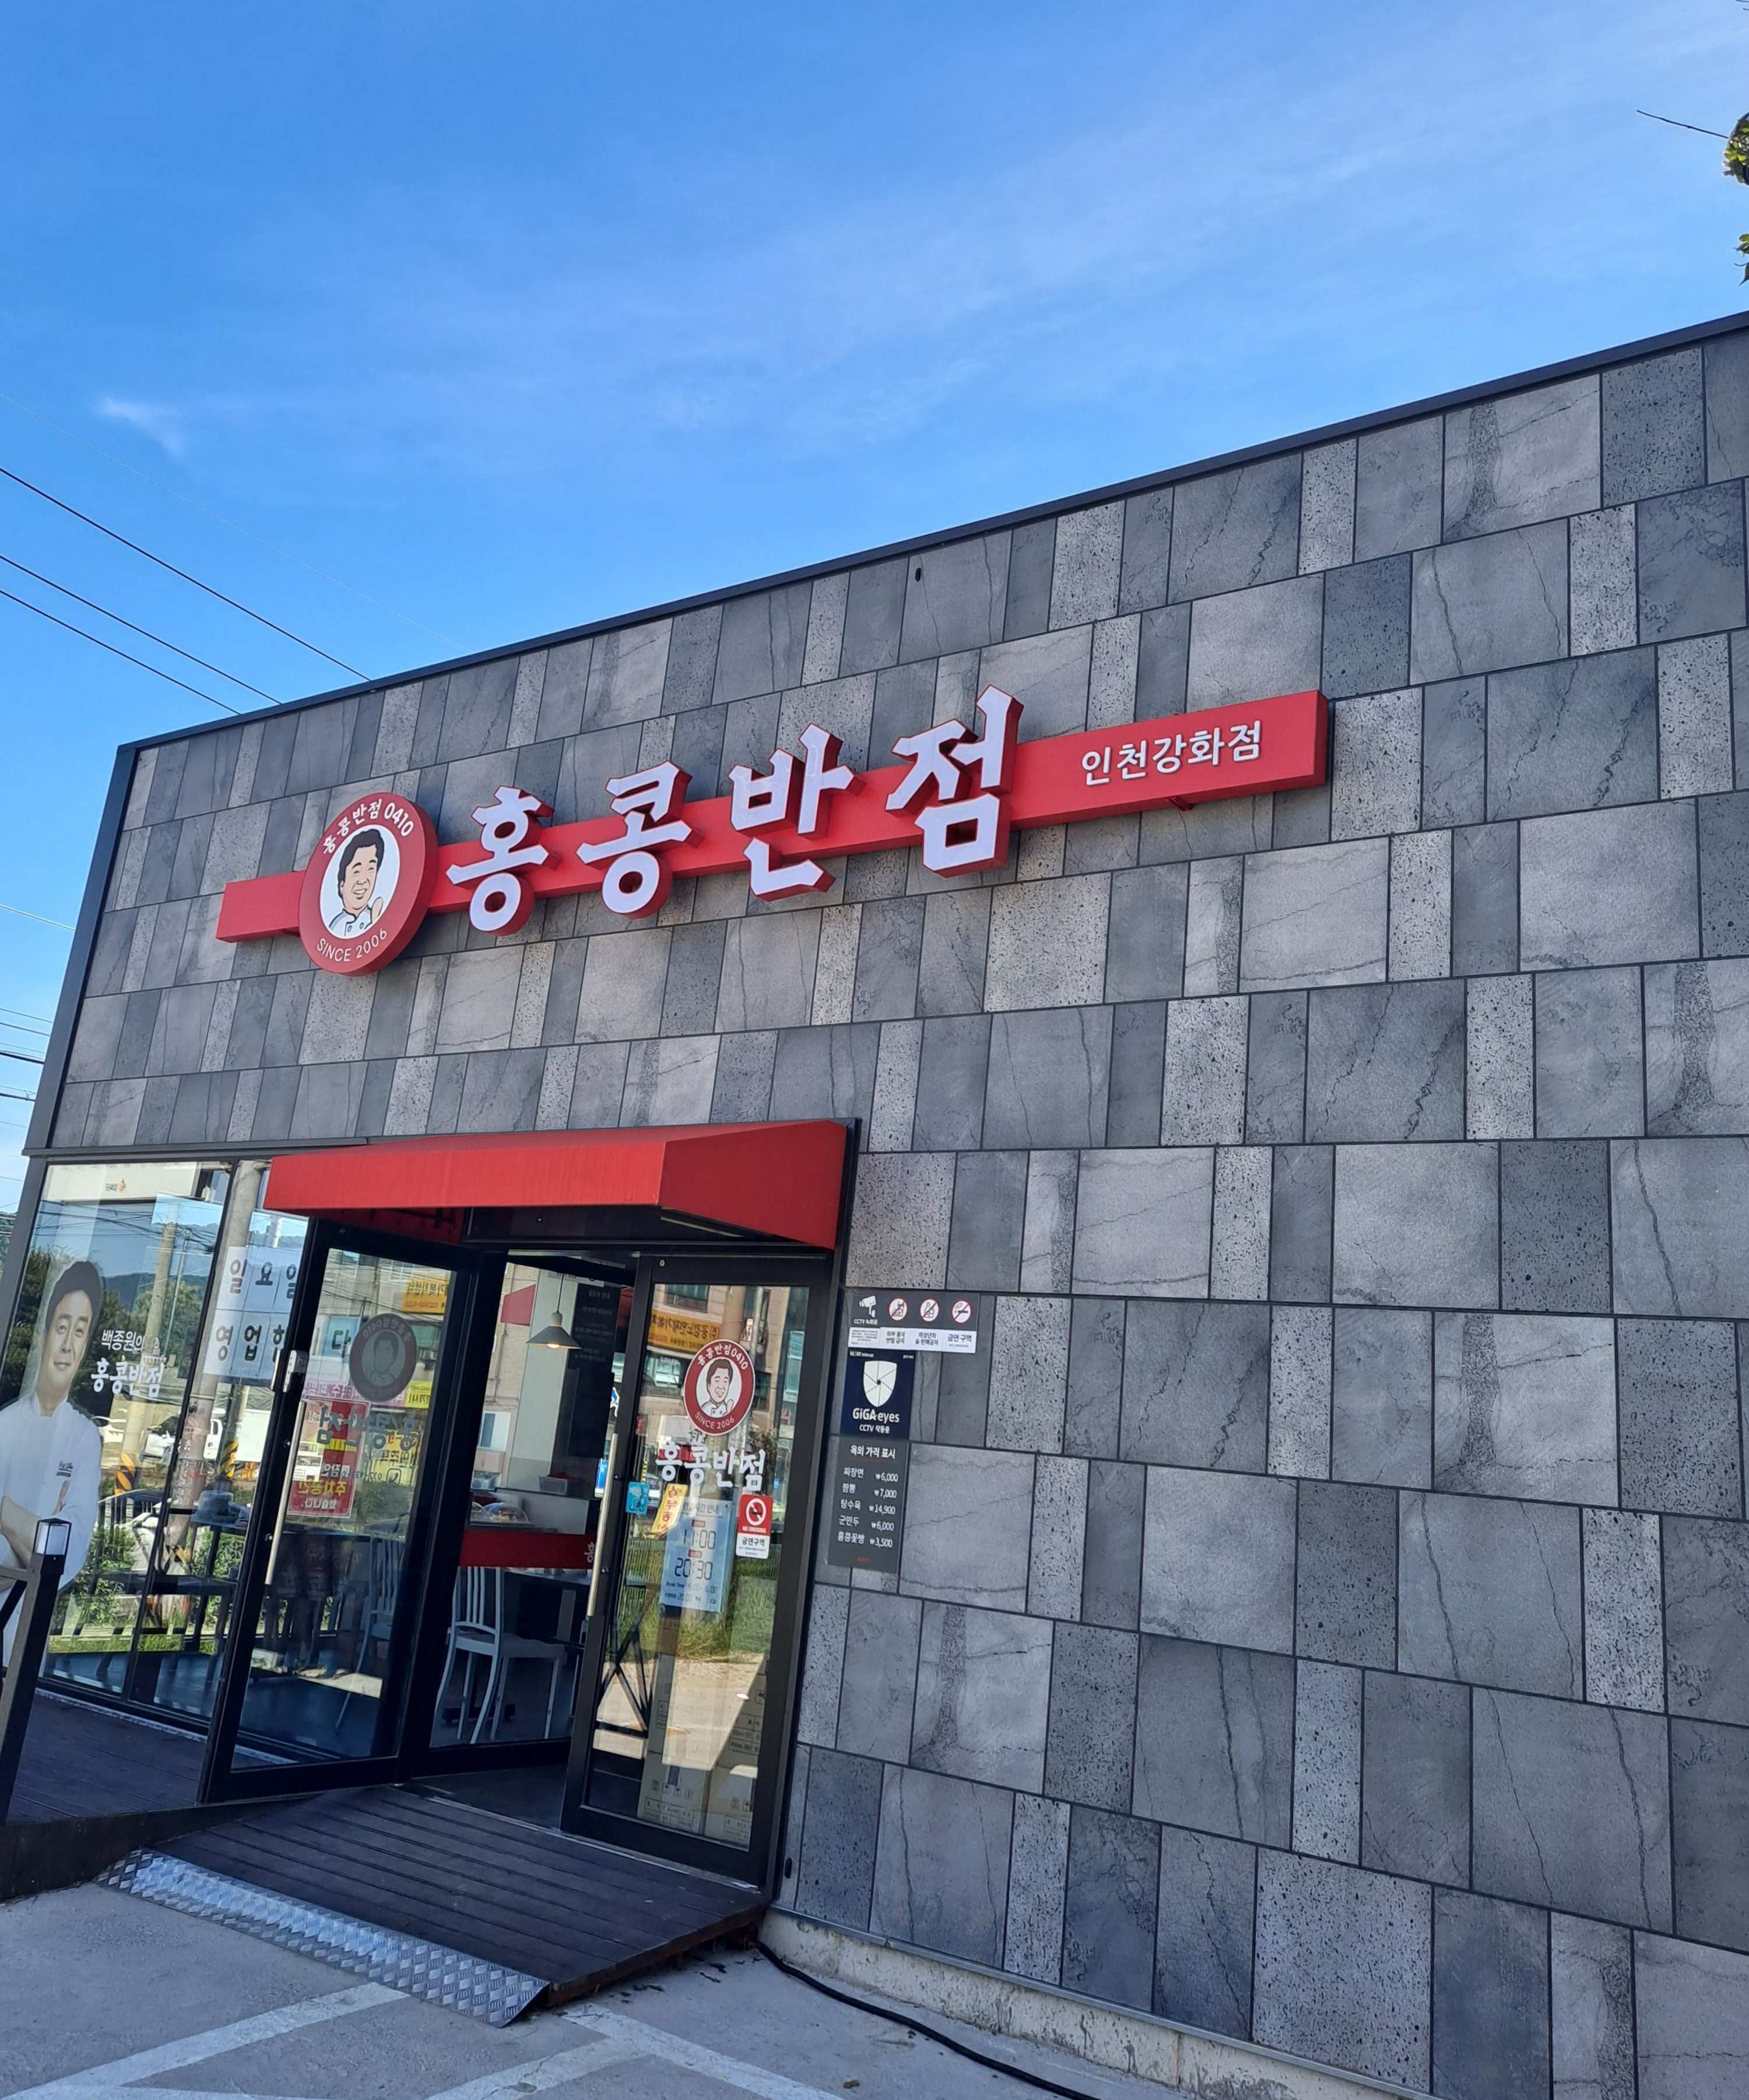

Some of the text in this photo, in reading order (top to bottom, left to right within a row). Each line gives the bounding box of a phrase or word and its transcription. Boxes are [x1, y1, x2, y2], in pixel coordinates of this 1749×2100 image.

[1081, 720, 1262, 786] 인천강화점
[446, 684, 1013, 931] 홍콩반점
[317, 928, 387, 962] SINCE 2006
[947, 1334, 972, 1343] 금연 구역
[91, 1357, 165, 1398] 홍콩반점
[694, 1412, 735, 1430] SINCE 2006
[859, 1424, 874, 1432] CCTV
[850, 1445, 895, 1459] 옥외 가격 표시
[655, 1440, 766, 1492] 홍콩반점
[840, 1499, 861, 1511] 탕수육
[838, 1515, 860, 1527] 군만두
[683, 1529, 717, 1549] 11:00
[742, 1536, 765, 1547] 금연구역
[675, 1557, 713, 1580] 20:30
